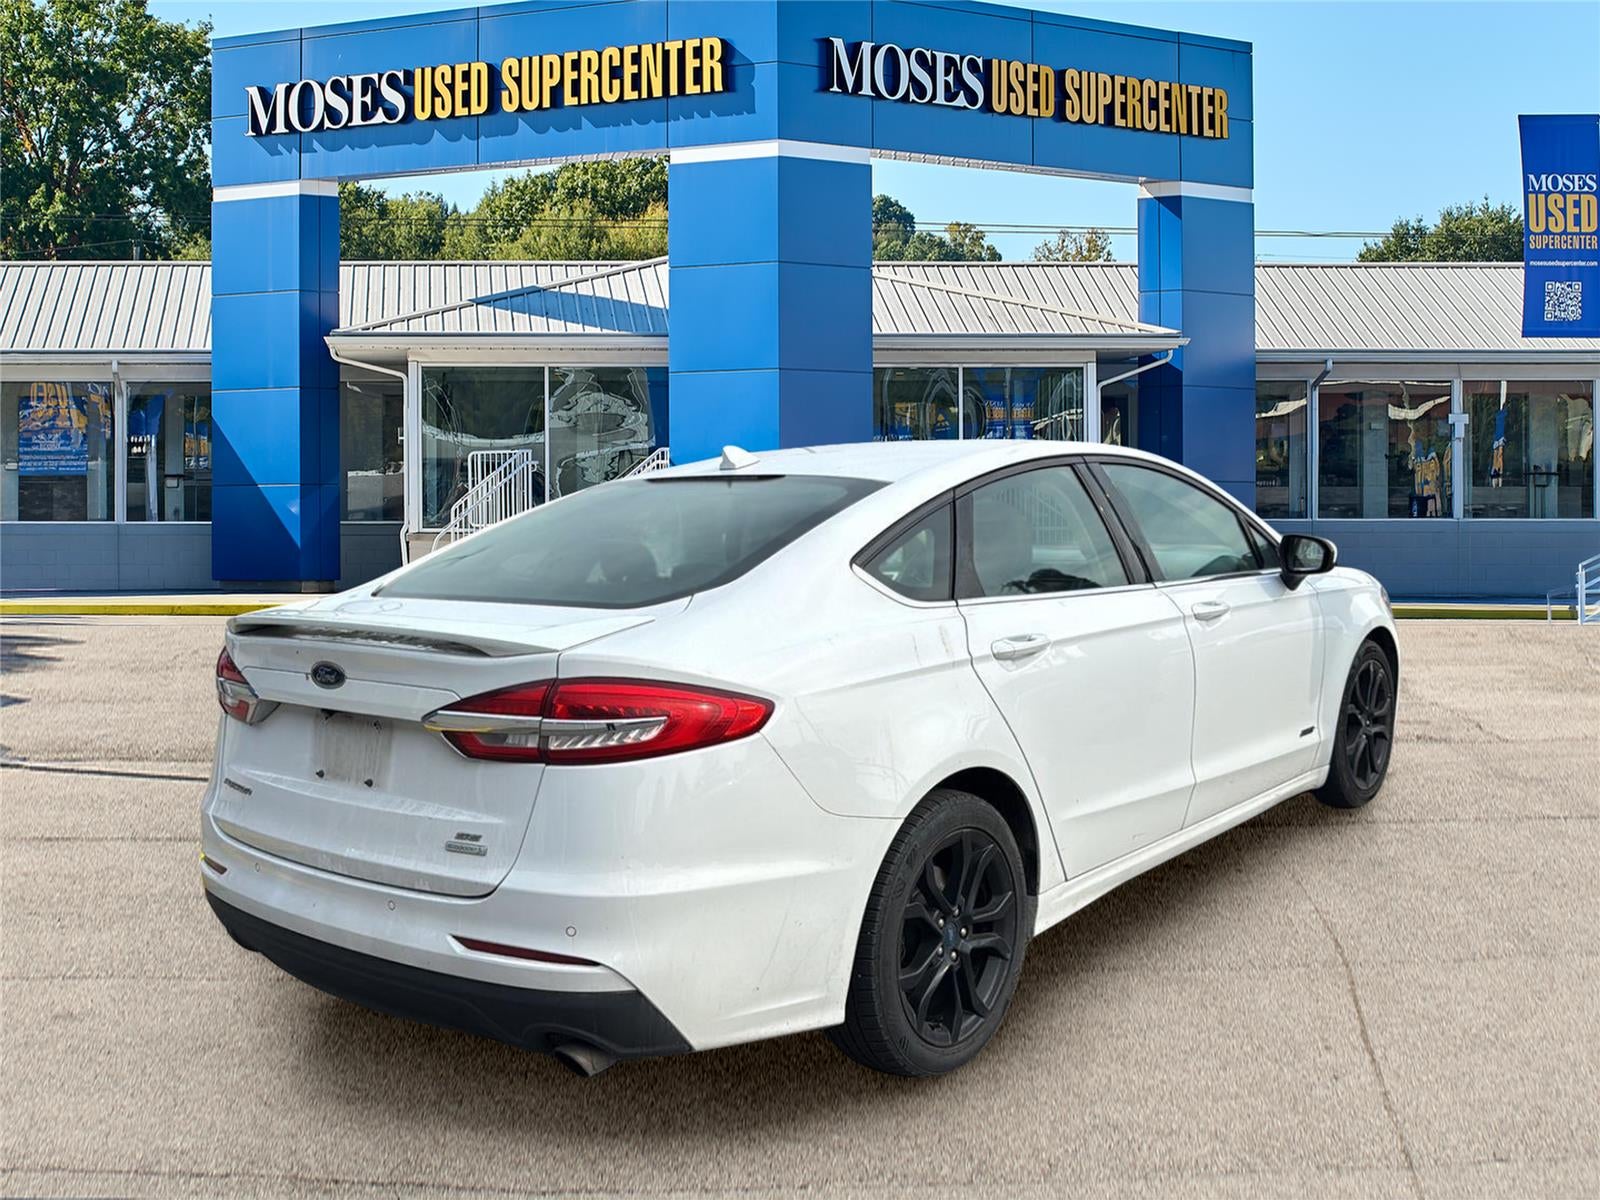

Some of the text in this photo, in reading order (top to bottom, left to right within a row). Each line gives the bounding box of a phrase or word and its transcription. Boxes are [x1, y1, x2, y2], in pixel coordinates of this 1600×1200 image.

[244, 37, 724, 137] MOSES USED SUPERCENTER
[829, 37, 1229, 139] MOSES USED SUPERCENTER
[1528, 173, 1597, 192] MOSES
[1528, 193, 1598, 233] USED
[1529, 235, 1598, 249] SUPERCENTER
